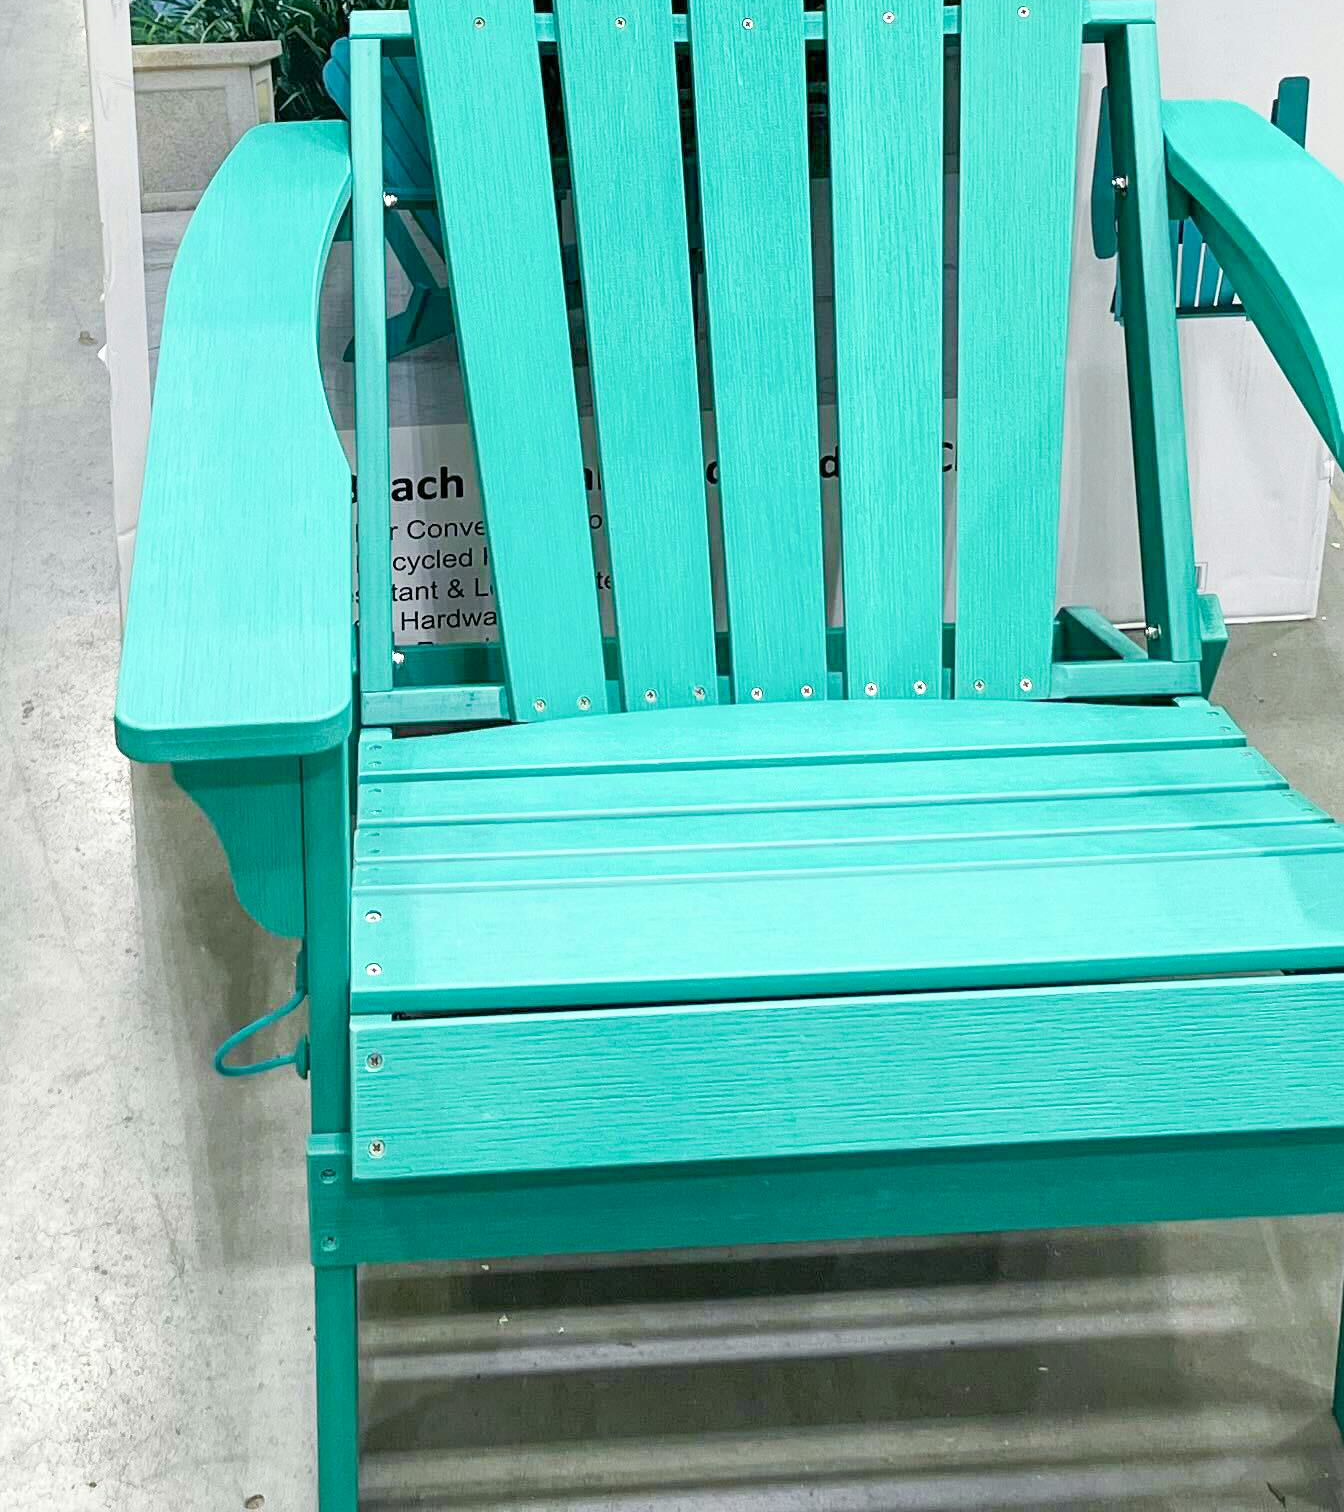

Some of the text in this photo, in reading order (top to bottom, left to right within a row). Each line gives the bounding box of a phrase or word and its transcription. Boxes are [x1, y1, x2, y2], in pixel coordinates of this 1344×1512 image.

[391, 466, 464, 502] ach
[408, 519, 484, 540] Conve
[392, 547, 473, 576] cycled
[392, 579, 465, 602] tant &
[401, 609, 497, 630] Hardwa
